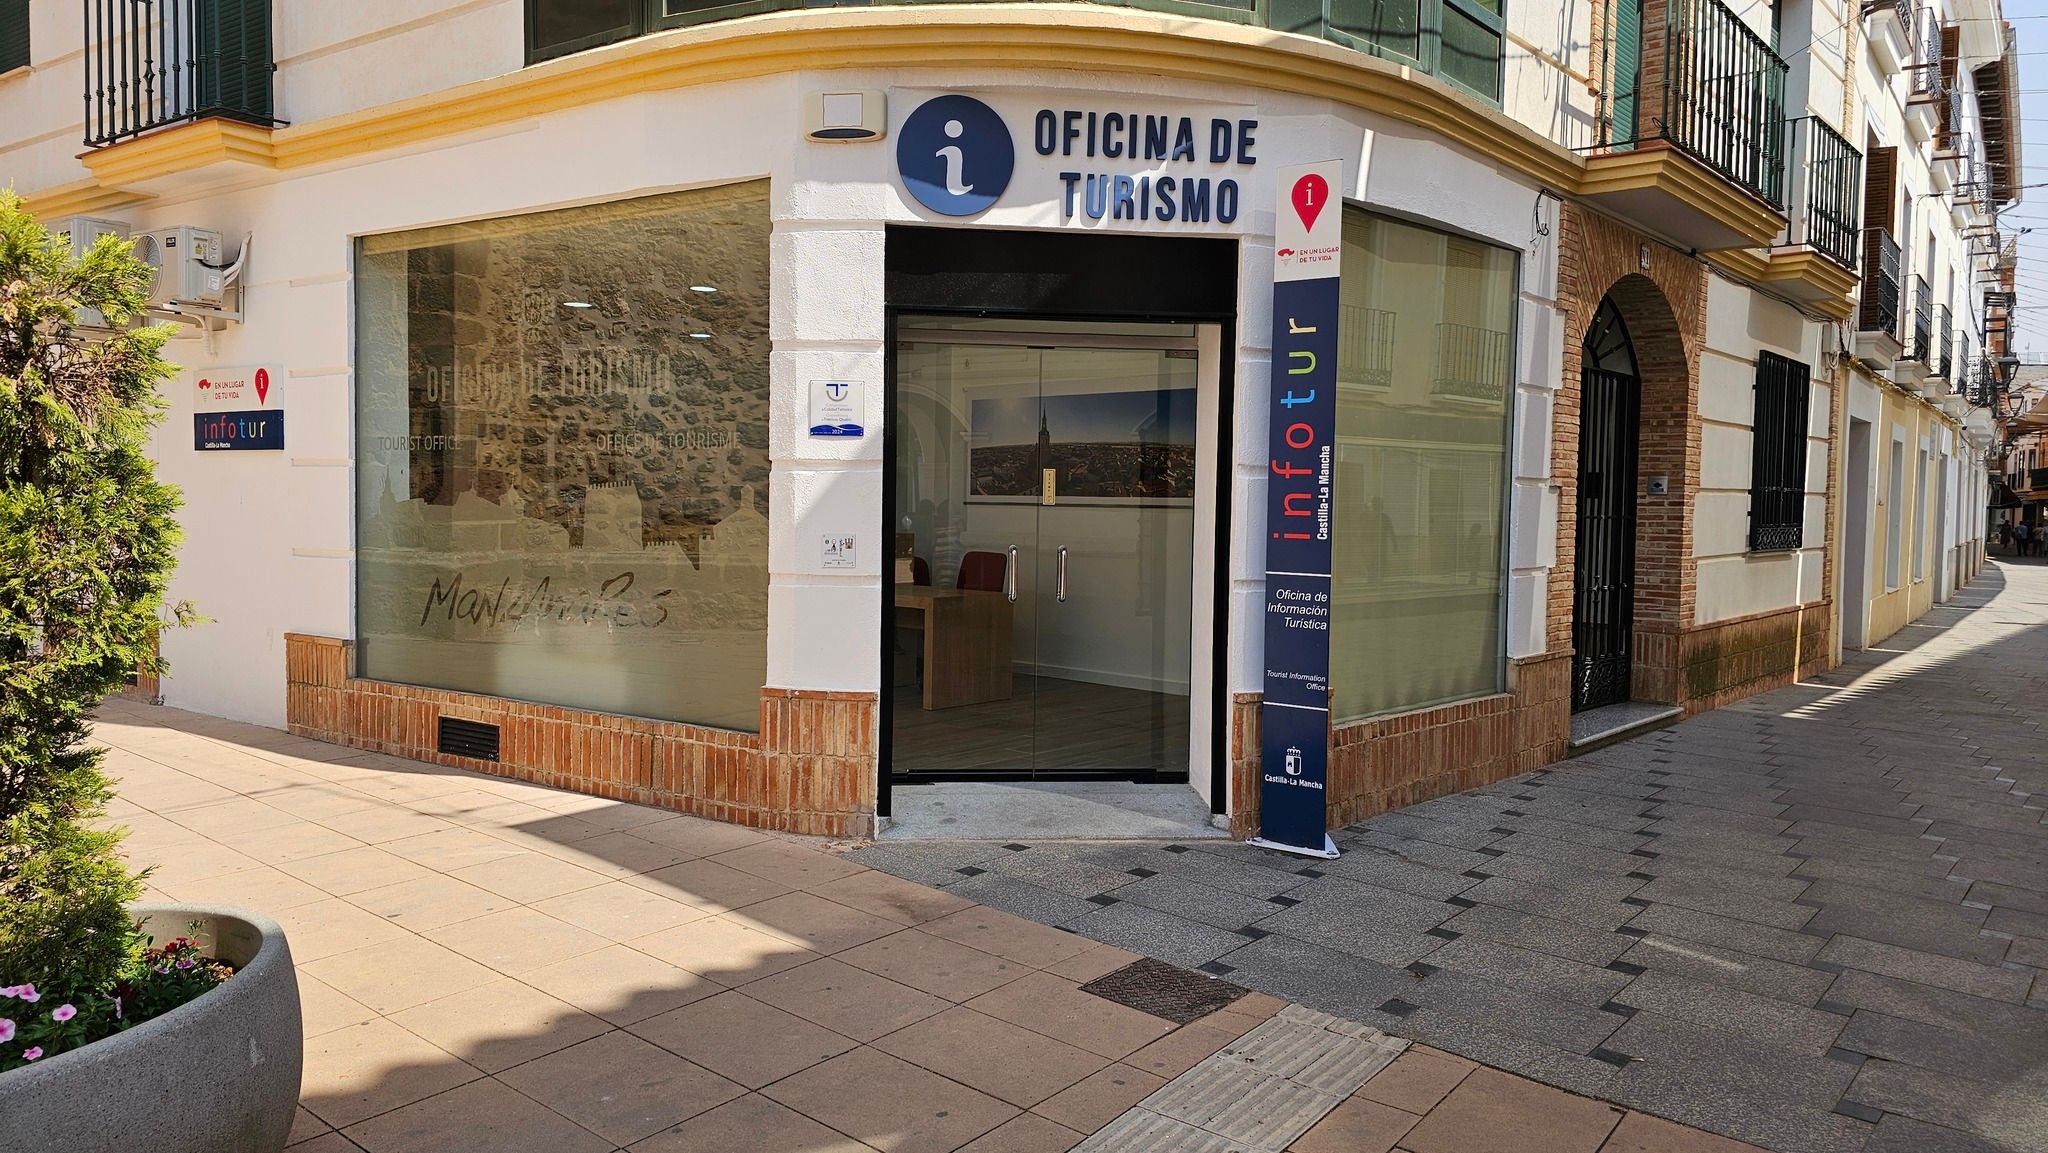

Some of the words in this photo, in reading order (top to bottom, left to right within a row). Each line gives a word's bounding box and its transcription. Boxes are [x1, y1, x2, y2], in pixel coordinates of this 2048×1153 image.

[1035, 109, 1195, 162] OFICINA
[1210, 118, 1258, 165] DE
[935, 119, 974, 196] i
[1060, 172, 1239, 224] TURISMO
[1305, 182, 1313, 205] i
[1319, 246, 1340, 254] LUGAR
[229, 380, 245, 388] LUGAR
[259, 373, 264, 388] i
[427, 362, 513, 402] OFICINA
[522, 362, 549, 397] DE
[560, 354, 671, 396] TURISMO
[204, 415, 266, 439] infotur
[1271, 318, 1317, 540] infotur
[378, 436, 422, 451] TOURIST
[423, 436, 463, 451] OFFICE
[597, 433, 641, 451] OFFICE
[644, 434, 662, 450] DE
[665, 431, 742, 450] TOURISME
[1318, 445, 1330, 485] Mancha
[1317, 486, 1329, 540] Castilla-La
[1276, 589, 1311, 602] Oficina
[1314, 592, 1328, 602] de
[1267, 602, 1328, 616] Información
[1284, 617, 1327, 630] Turística
[1267, 670, 1288, 679] Tourist
[1289, 672, 1326, 682] Information
[1306, 682, 1326, 692] Office
[1264, 773, 1297, 786] Castilla-La
[1298, 778, 1323, 790] Mancha
